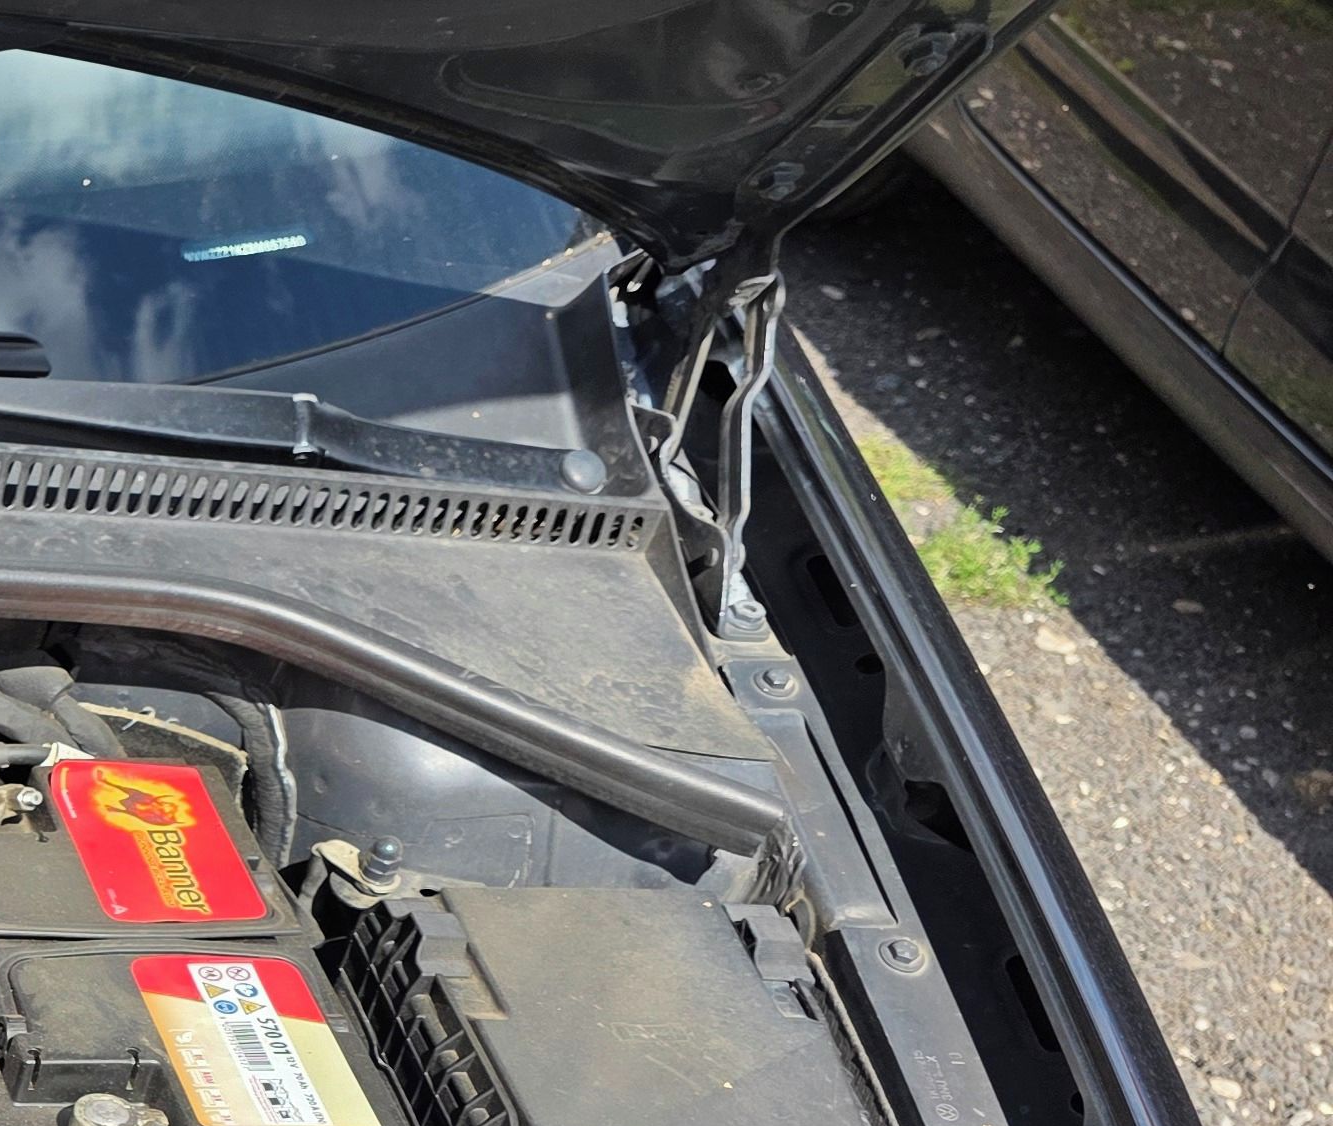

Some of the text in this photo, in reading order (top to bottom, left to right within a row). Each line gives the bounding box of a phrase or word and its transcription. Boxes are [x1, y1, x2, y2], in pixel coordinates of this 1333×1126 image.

[147, 830, 209, 913] Banner
[257, 1018, 282, 1038] 570
[270, 1042, 292, 1054] 01
